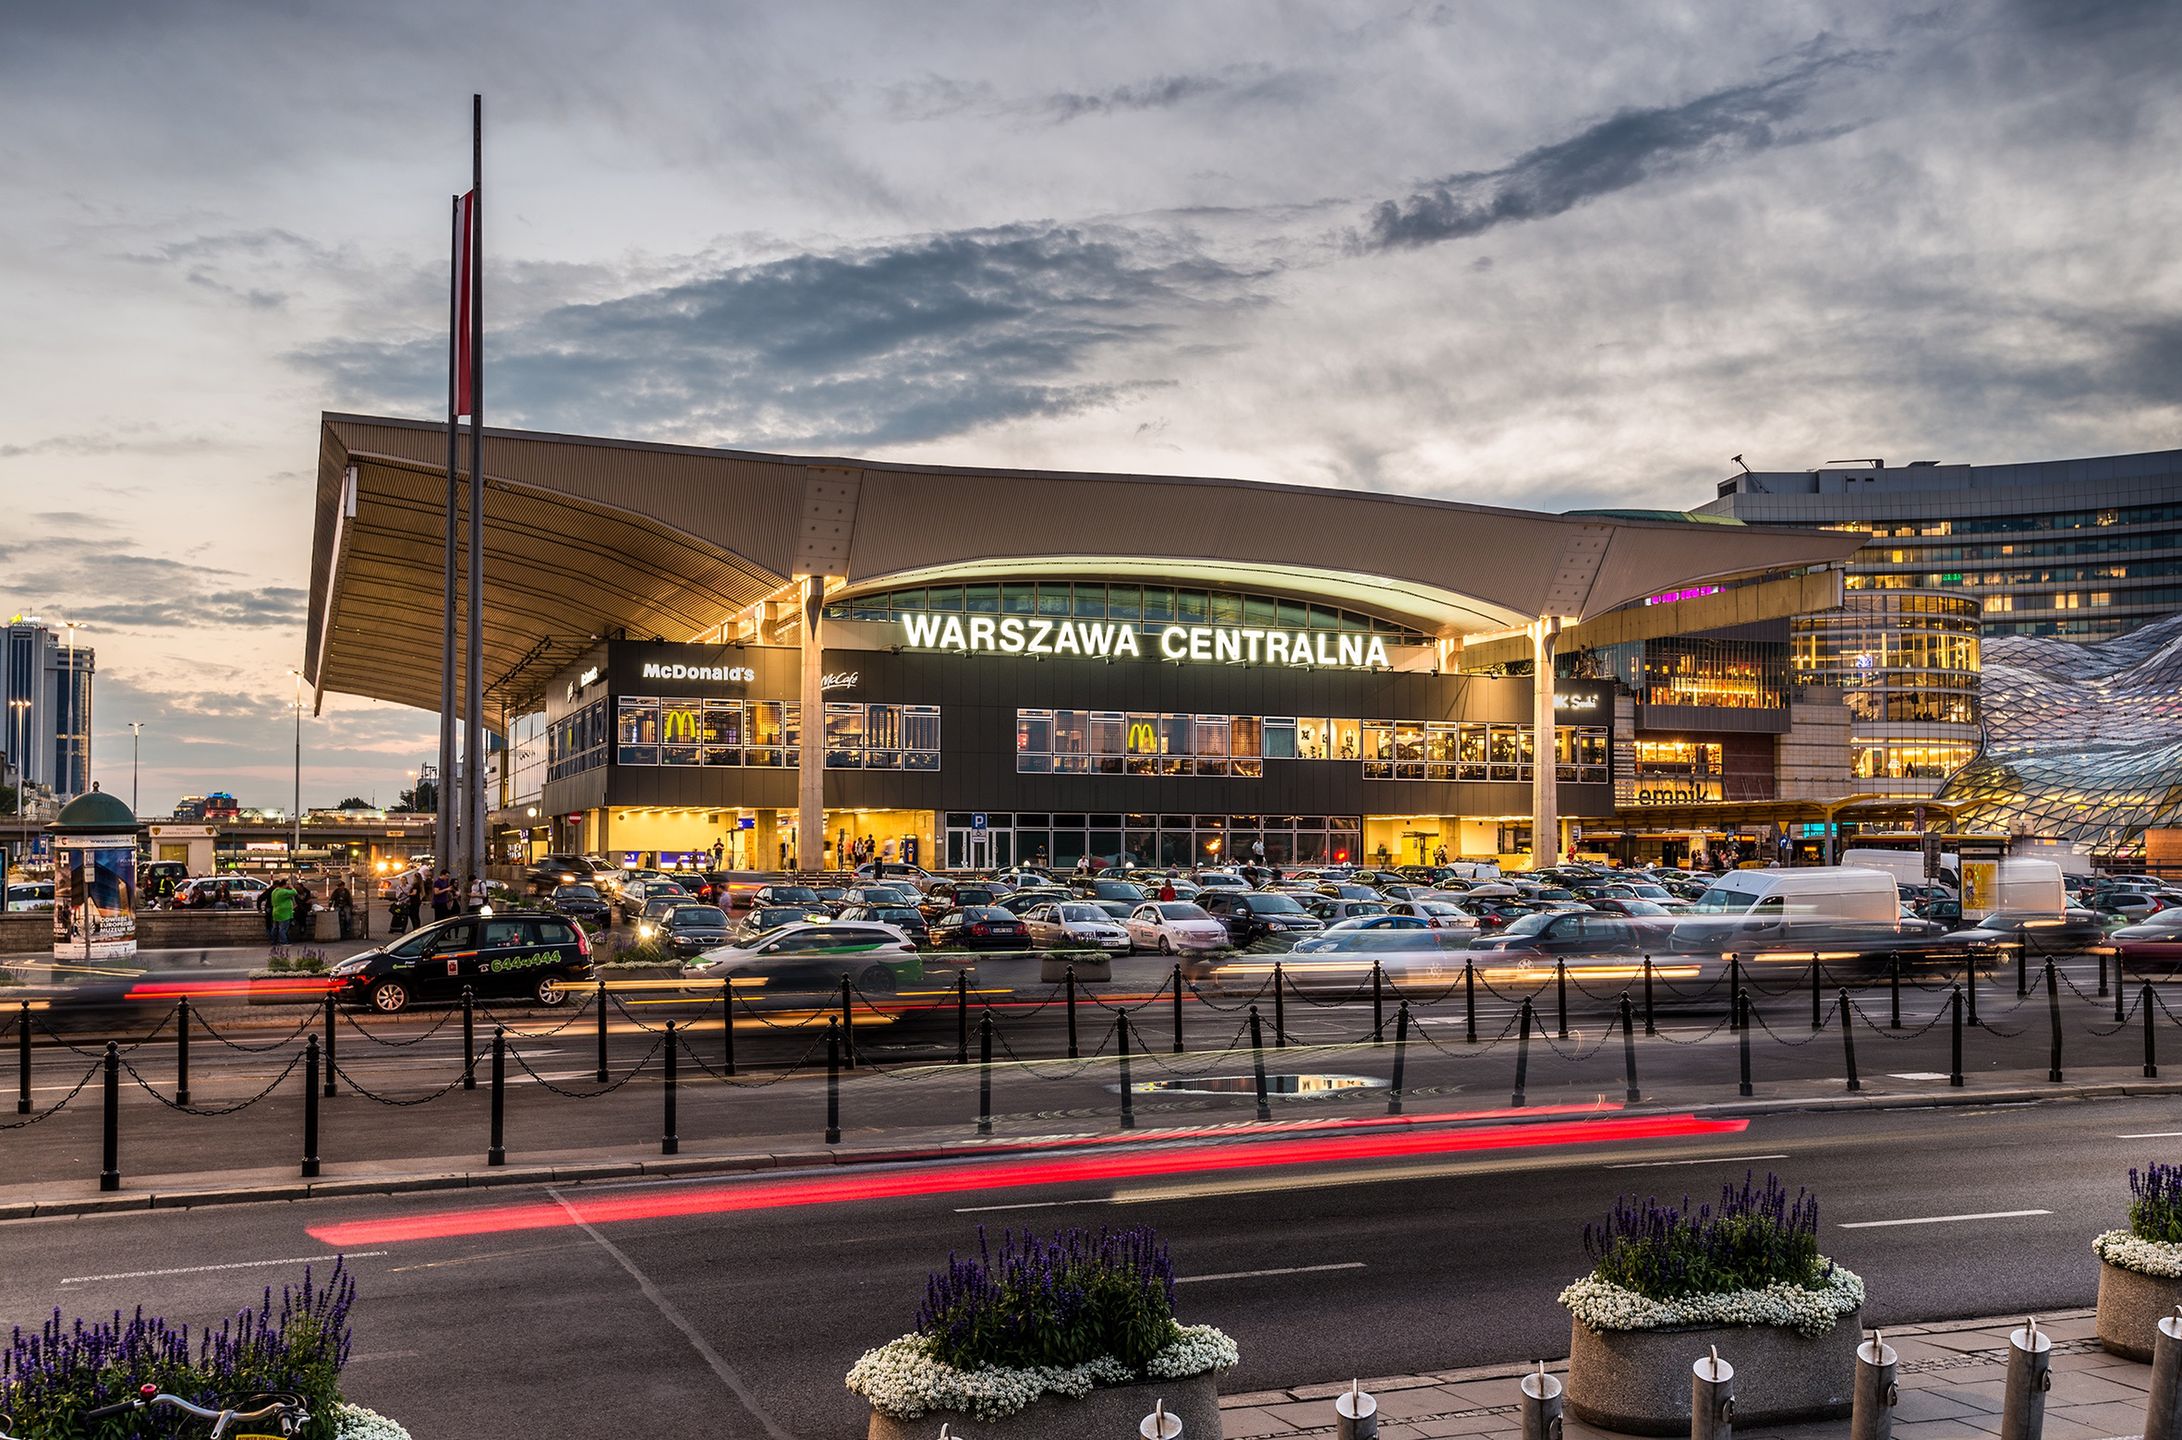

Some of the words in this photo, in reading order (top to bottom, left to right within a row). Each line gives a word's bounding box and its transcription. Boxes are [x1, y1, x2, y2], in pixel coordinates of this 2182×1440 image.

[902, 613, 1140, 657] WARSZAWA
[1160, 626, 1390, 667] CENTRALNA
[642, 663, 755, 682] McDonald's
[975, 815, 985, 828] P
